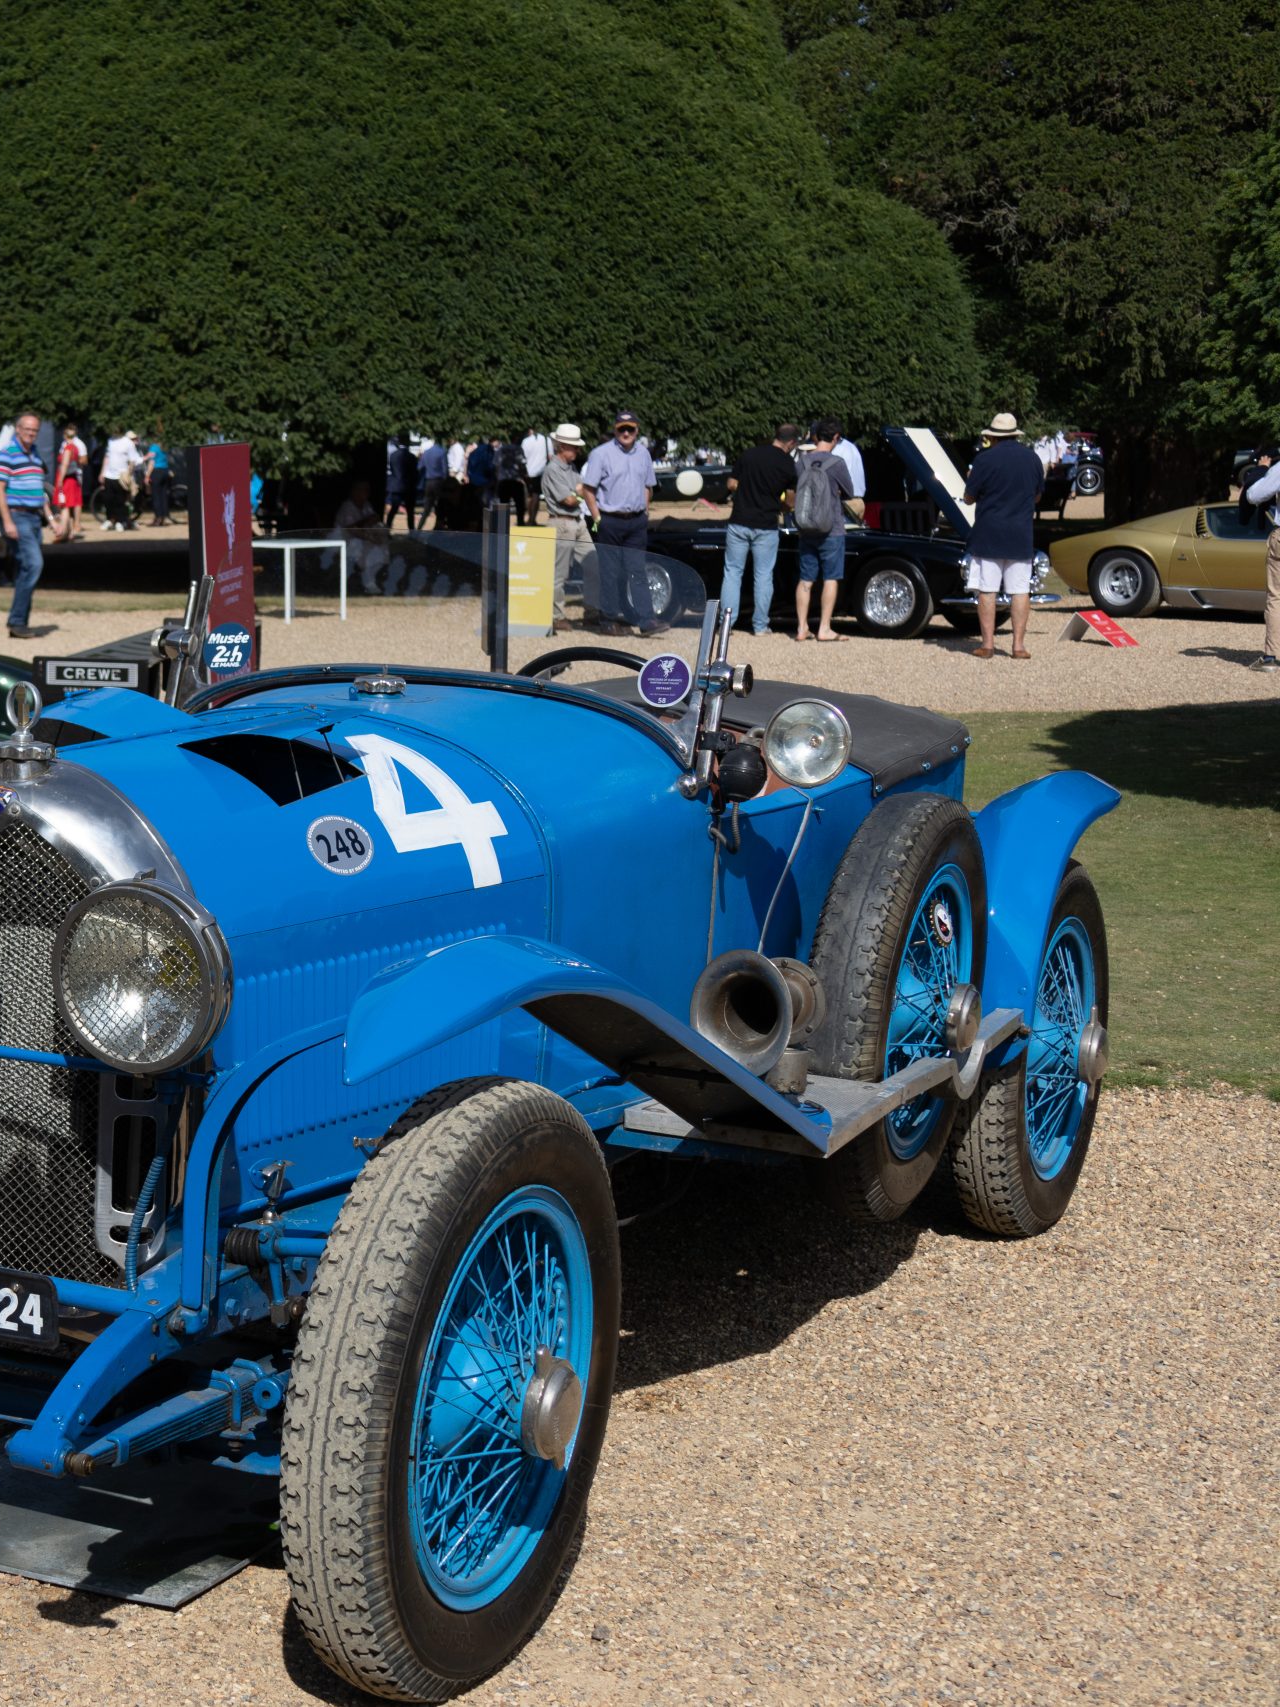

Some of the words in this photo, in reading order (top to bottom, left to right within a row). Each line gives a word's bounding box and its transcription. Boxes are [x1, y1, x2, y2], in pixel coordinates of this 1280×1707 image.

[208, 632, 250, 644] Musée
[211, 645, 243, 663] 24h
[63, 667, 122, 681] CREWE
[344, 733, 508, 889] 4
[316, 828, 365, 863] 248
